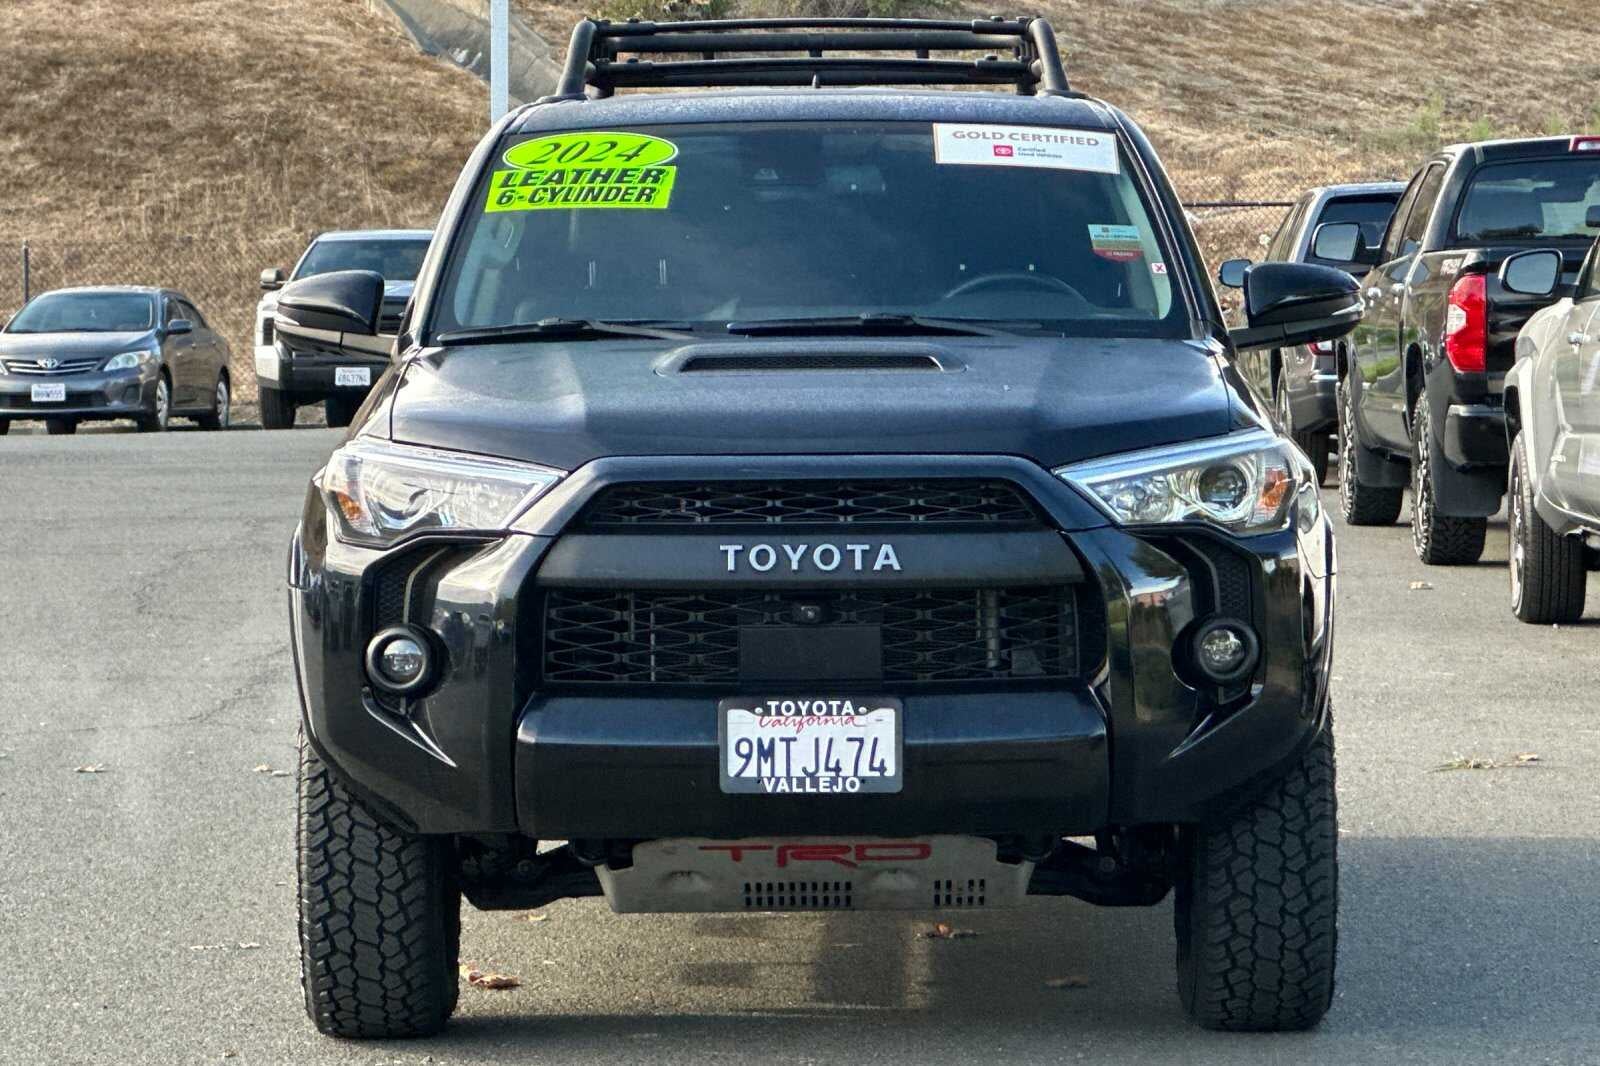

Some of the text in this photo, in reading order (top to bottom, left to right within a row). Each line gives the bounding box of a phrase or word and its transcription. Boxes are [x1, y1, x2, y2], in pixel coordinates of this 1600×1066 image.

[952, 130, 1100, 147] GOLD CERTIFIED
[526, 140, 655, 165] 2024
[499, 168, 666, 188] LEATHER
[496, 186, 658, 206] 6-CYLINDER
[719, 543, 902, 572] TOYOTA
[767, 700, 855, 716] TOYOTA
[734, 736, 888, 777] 9MTJ474
[762, 776, 861, 793] VALLEJO
[698, 843, 932, 868] TRD
